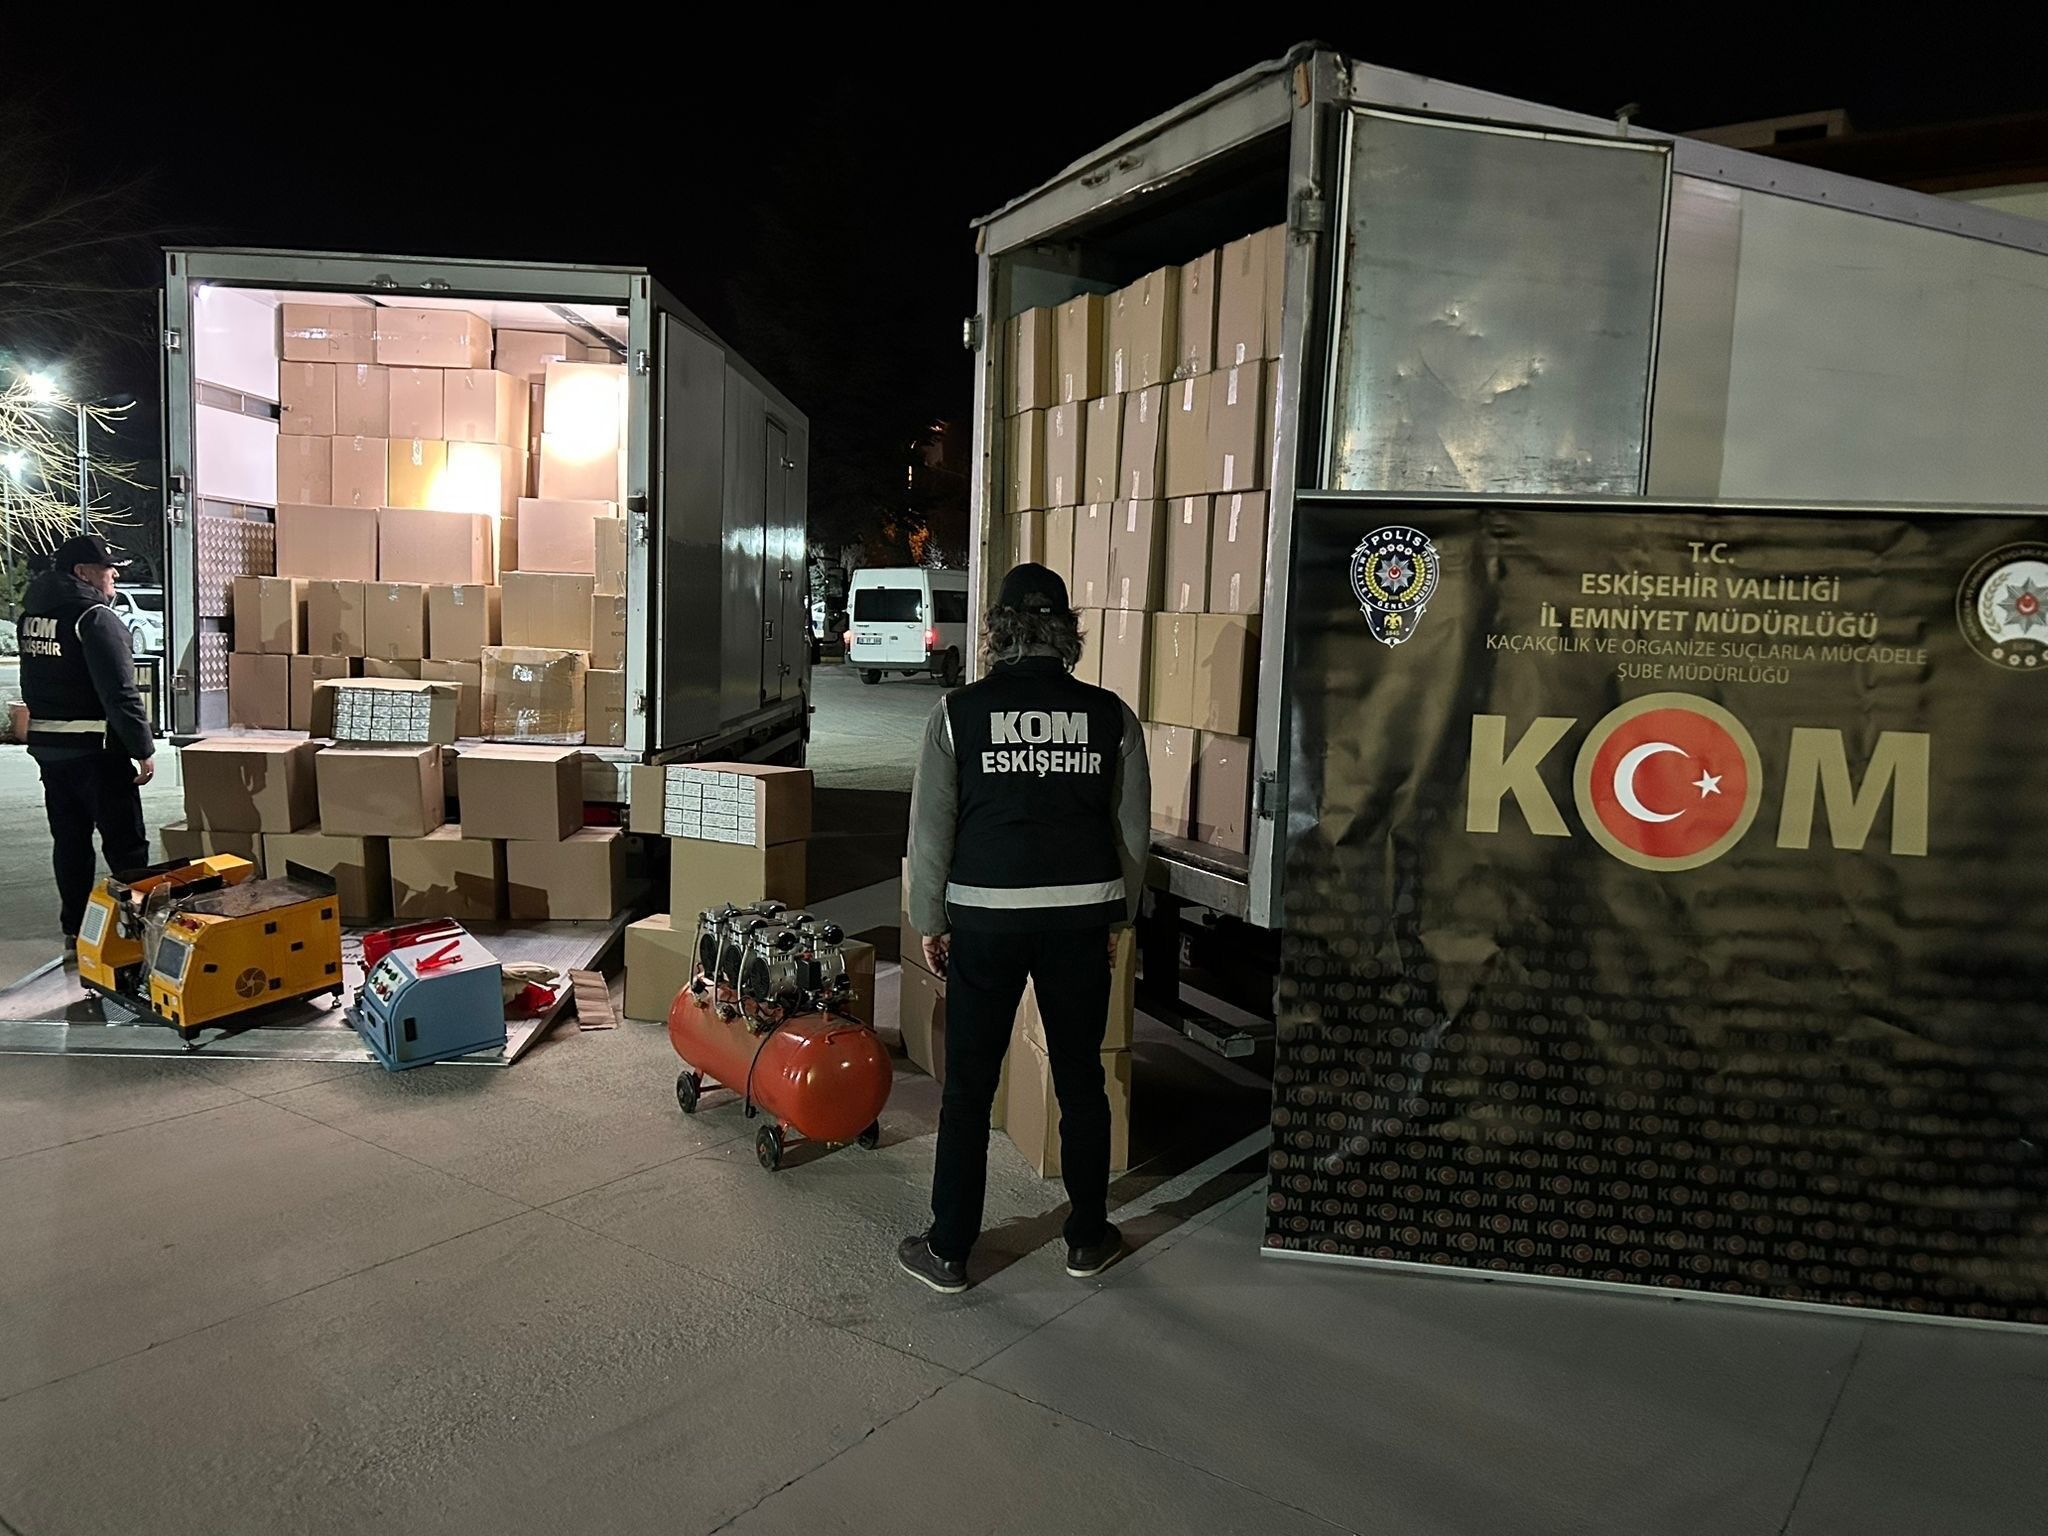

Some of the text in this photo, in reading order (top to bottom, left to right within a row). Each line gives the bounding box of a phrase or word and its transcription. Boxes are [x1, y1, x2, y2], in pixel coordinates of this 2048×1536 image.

[1688, 542, 1735, 565] T.C.
[1581, 570, 1840, 602] ESKİŞEHİR VALİLİĞİ
[1541, 601, 1879, 639] İL EMNİYET MÜDÜRLÜĞÜ
[1486, 634, 1927, 665] KAÇAKÇILIK VE ORGANİZE SUÇLARLA MÜCADELE
[1616, 662, 1790, 684] ŞUBE MÜDÜRLÜĞÜ
[990, 711, 1088, 744] KOM
[981, 745, 1102, 777] ESKİŞEHİR
